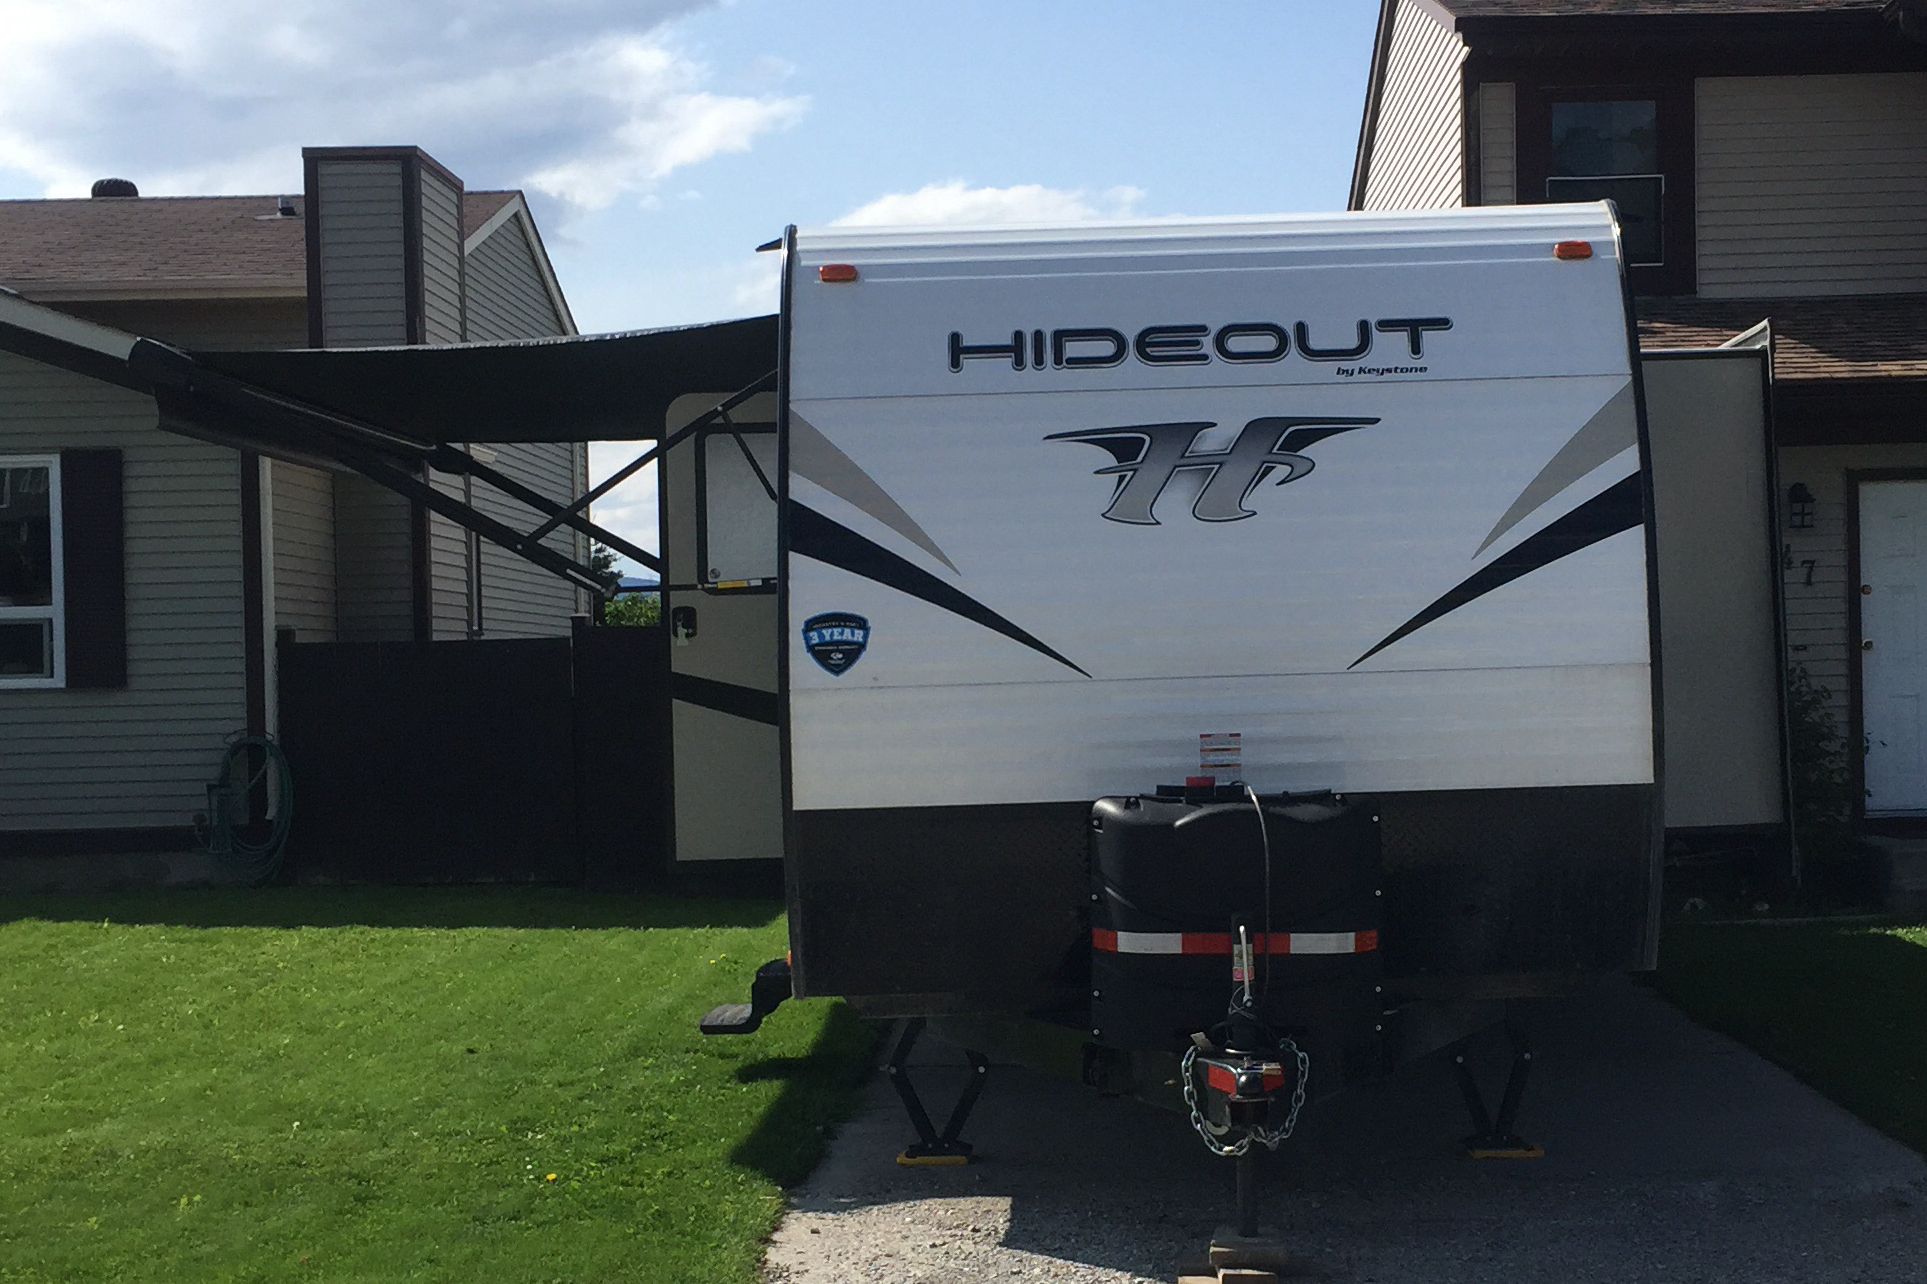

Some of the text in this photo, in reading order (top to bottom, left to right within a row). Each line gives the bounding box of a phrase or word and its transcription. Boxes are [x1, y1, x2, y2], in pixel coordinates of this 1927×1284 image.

[948, 317, 1453, 372] HIDEOUT
[1336, 366, 1428, 377] by Keystone
[809, 628, 864, 644] 3 YEAR
